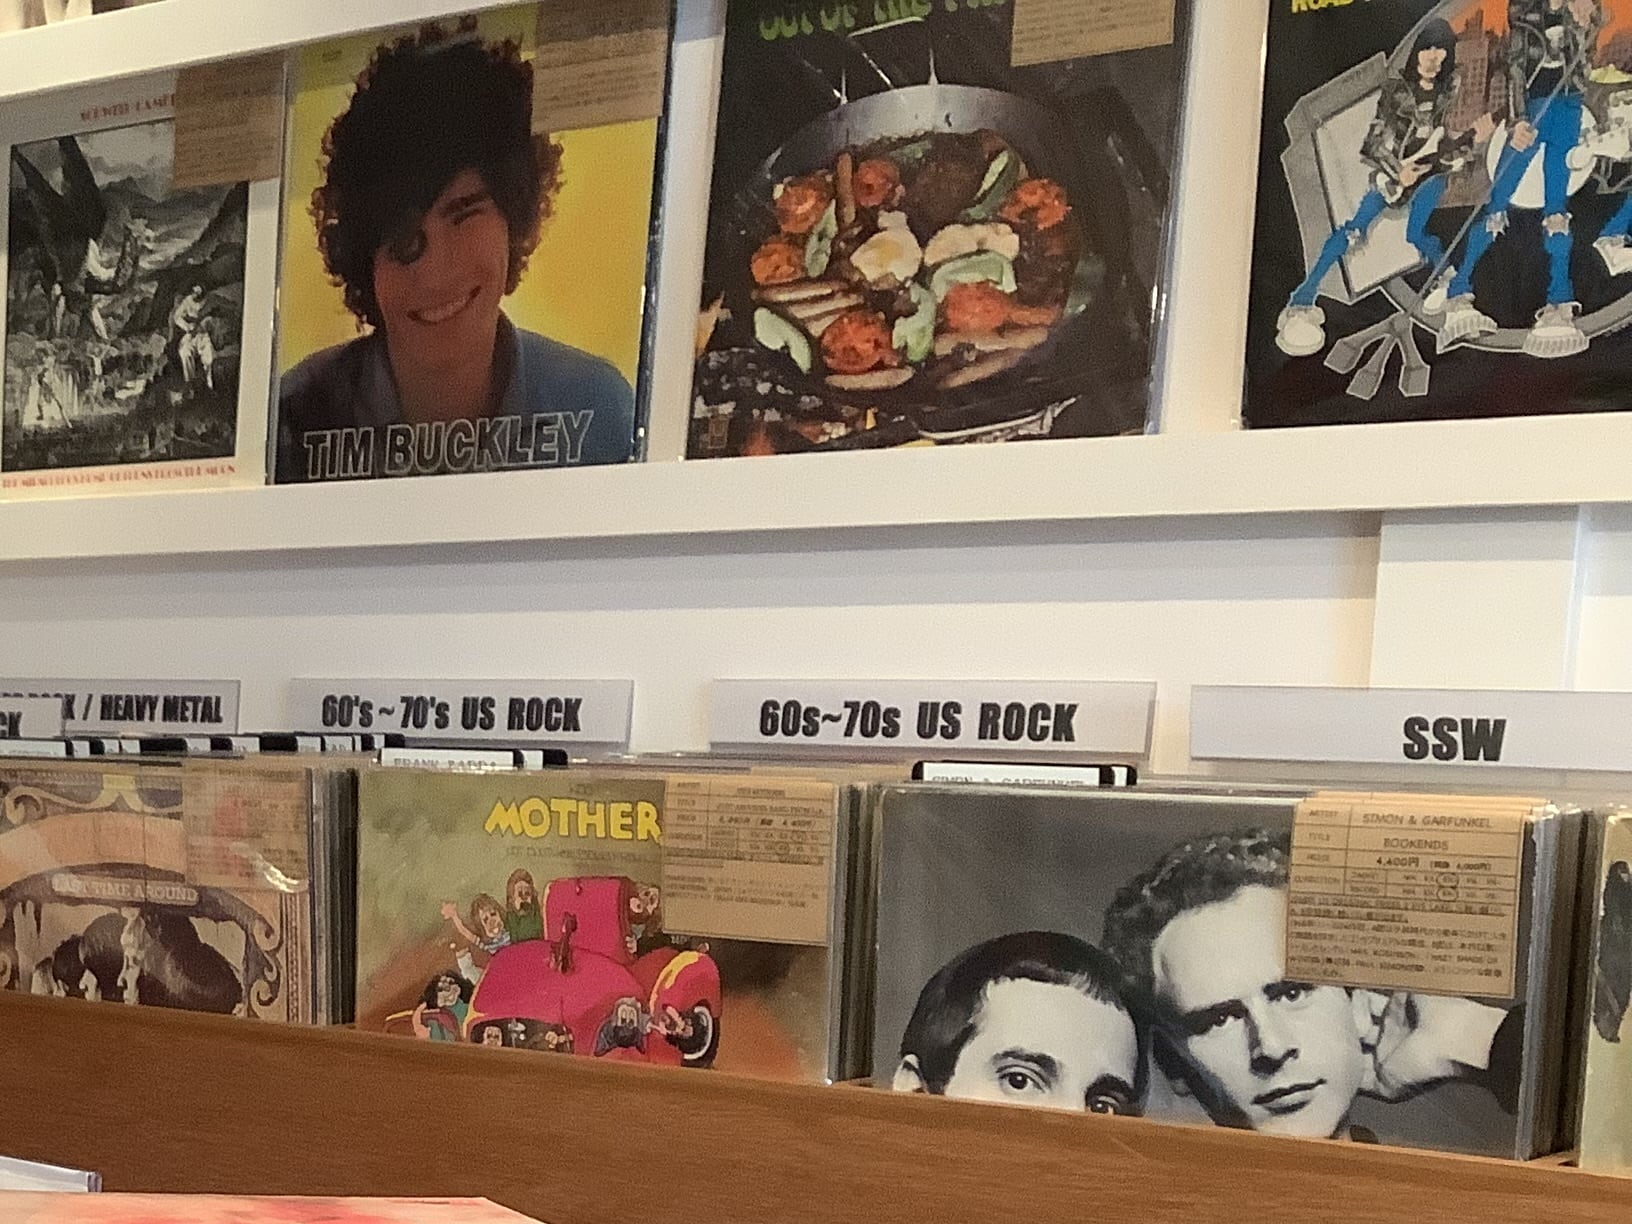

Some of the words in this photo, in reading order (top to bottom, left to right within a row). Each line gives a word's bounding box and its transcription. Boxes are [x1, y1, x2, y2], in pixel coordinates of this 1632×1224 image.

[304, 426, 374, 479] TIM
[385, 409, 594, 475] BUCKLEY
[100, 694, 159, 723] HEAVY
[162, 694, 223, 724] METAL
[461, 696, 496, 731] US
[507, 697, 583, 732] ROCK
[915, 700, 963, 740] US
[978, 702, 1079, 743] ROCK
[1403, 716, 1507, 761] SSW
[1362, 813, 1404, 826] SIMON
[1408, 814, 1418, 826] &
[1422, 815, 1493, 829] GARFUNKEL
[1383, 838, 1450, 850] BOOKENDS
